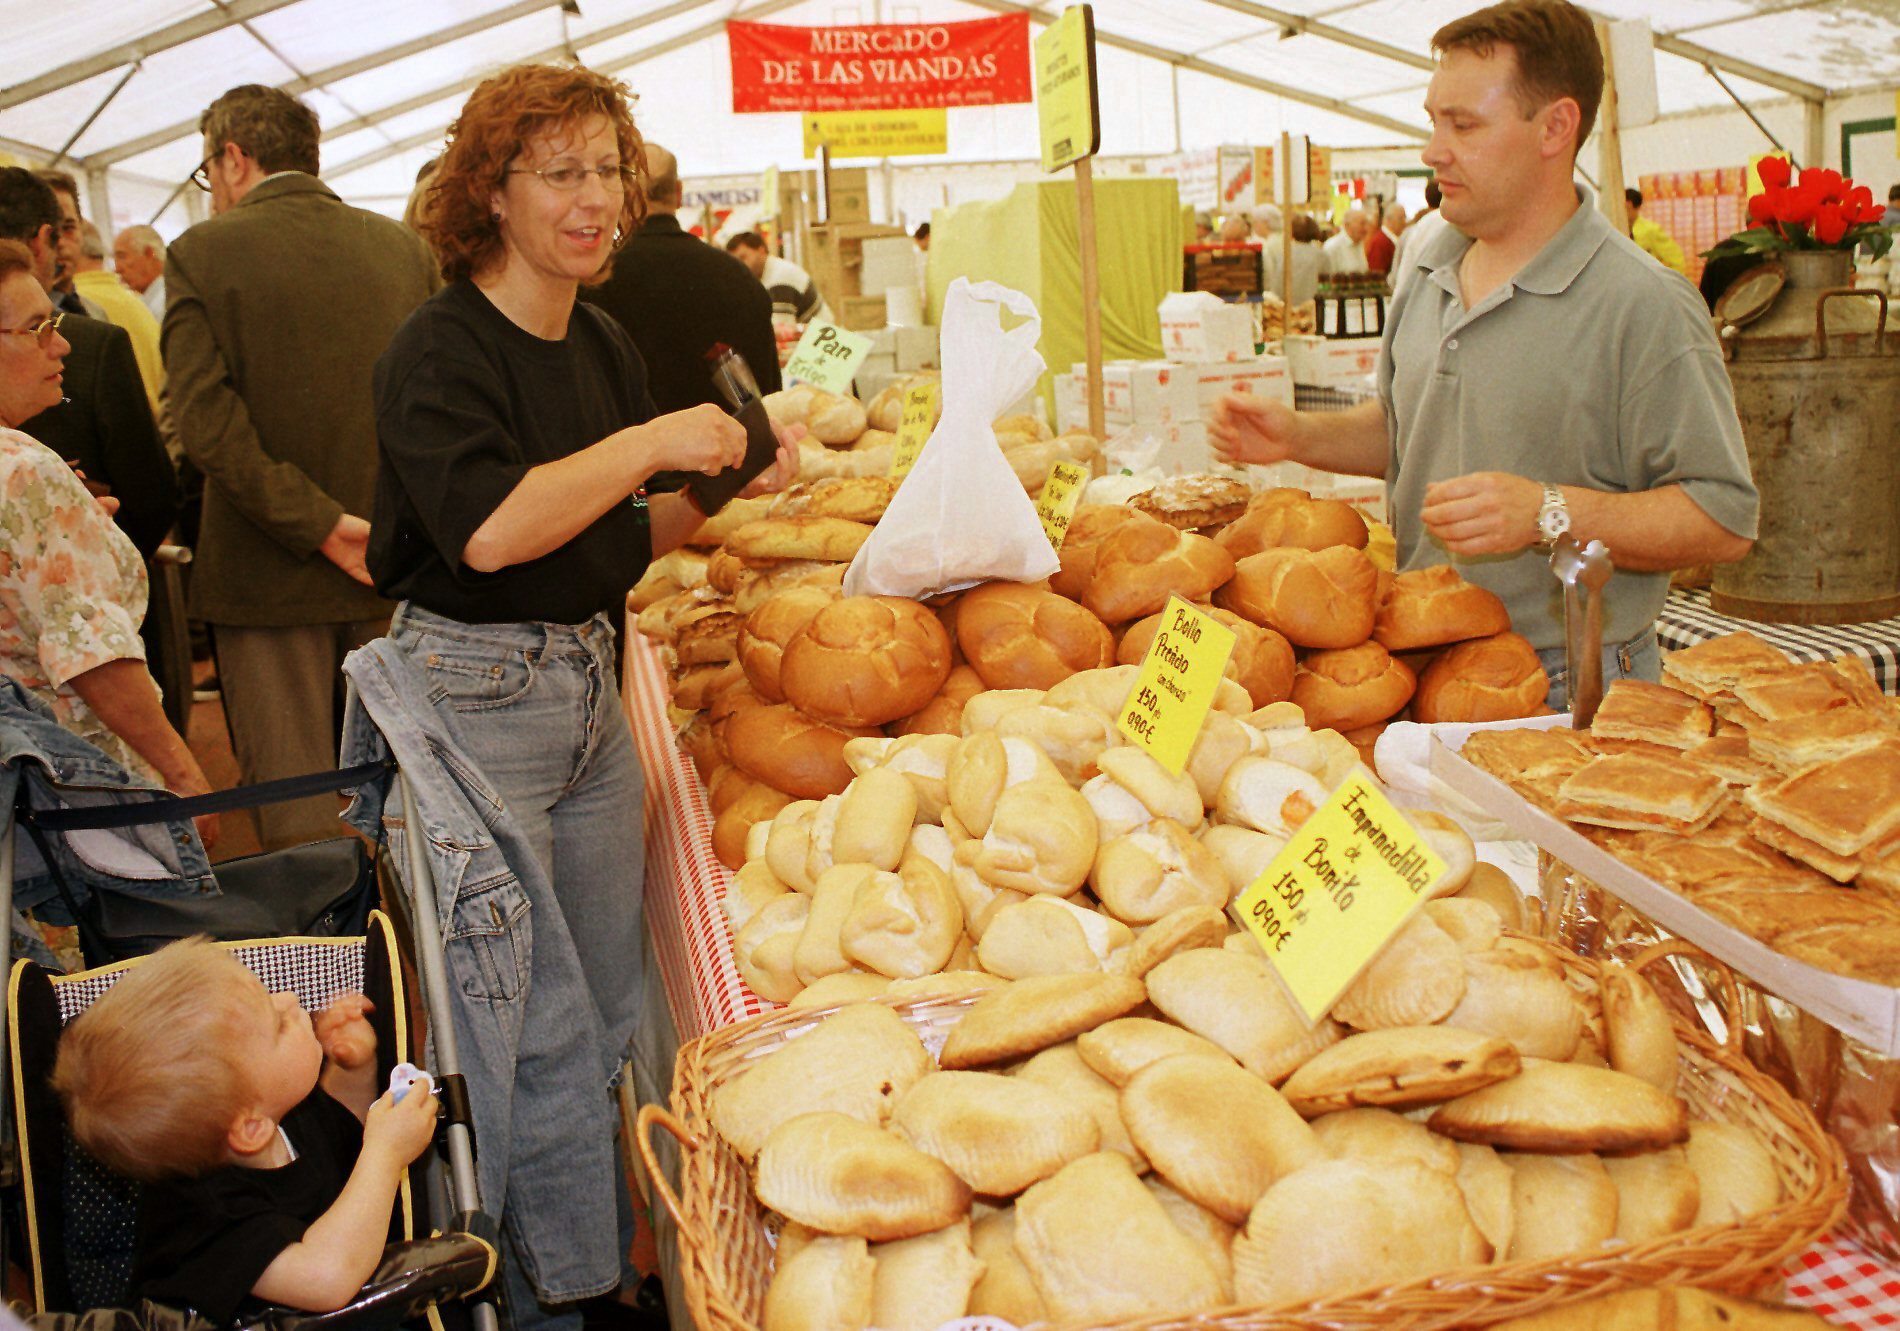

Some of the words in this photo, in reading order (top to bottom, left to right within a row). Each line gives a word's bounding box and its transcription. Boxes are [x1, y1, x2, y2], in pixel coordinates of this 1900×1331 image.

[762, 60, 803, 85] DE
[812, 60, 864, 85] LAS
[869, 54, 997, 83] VIANDAS
[813, 326, 852, 360] Pan
[1172, 608, 1202, 644] Bollo
[1136, 685, 1158, 712] 150
[1344, 842, 1362, 863] de
[1272, 870, 1304, 910] 150
[1303, 837, 1361, 912] Bonito
